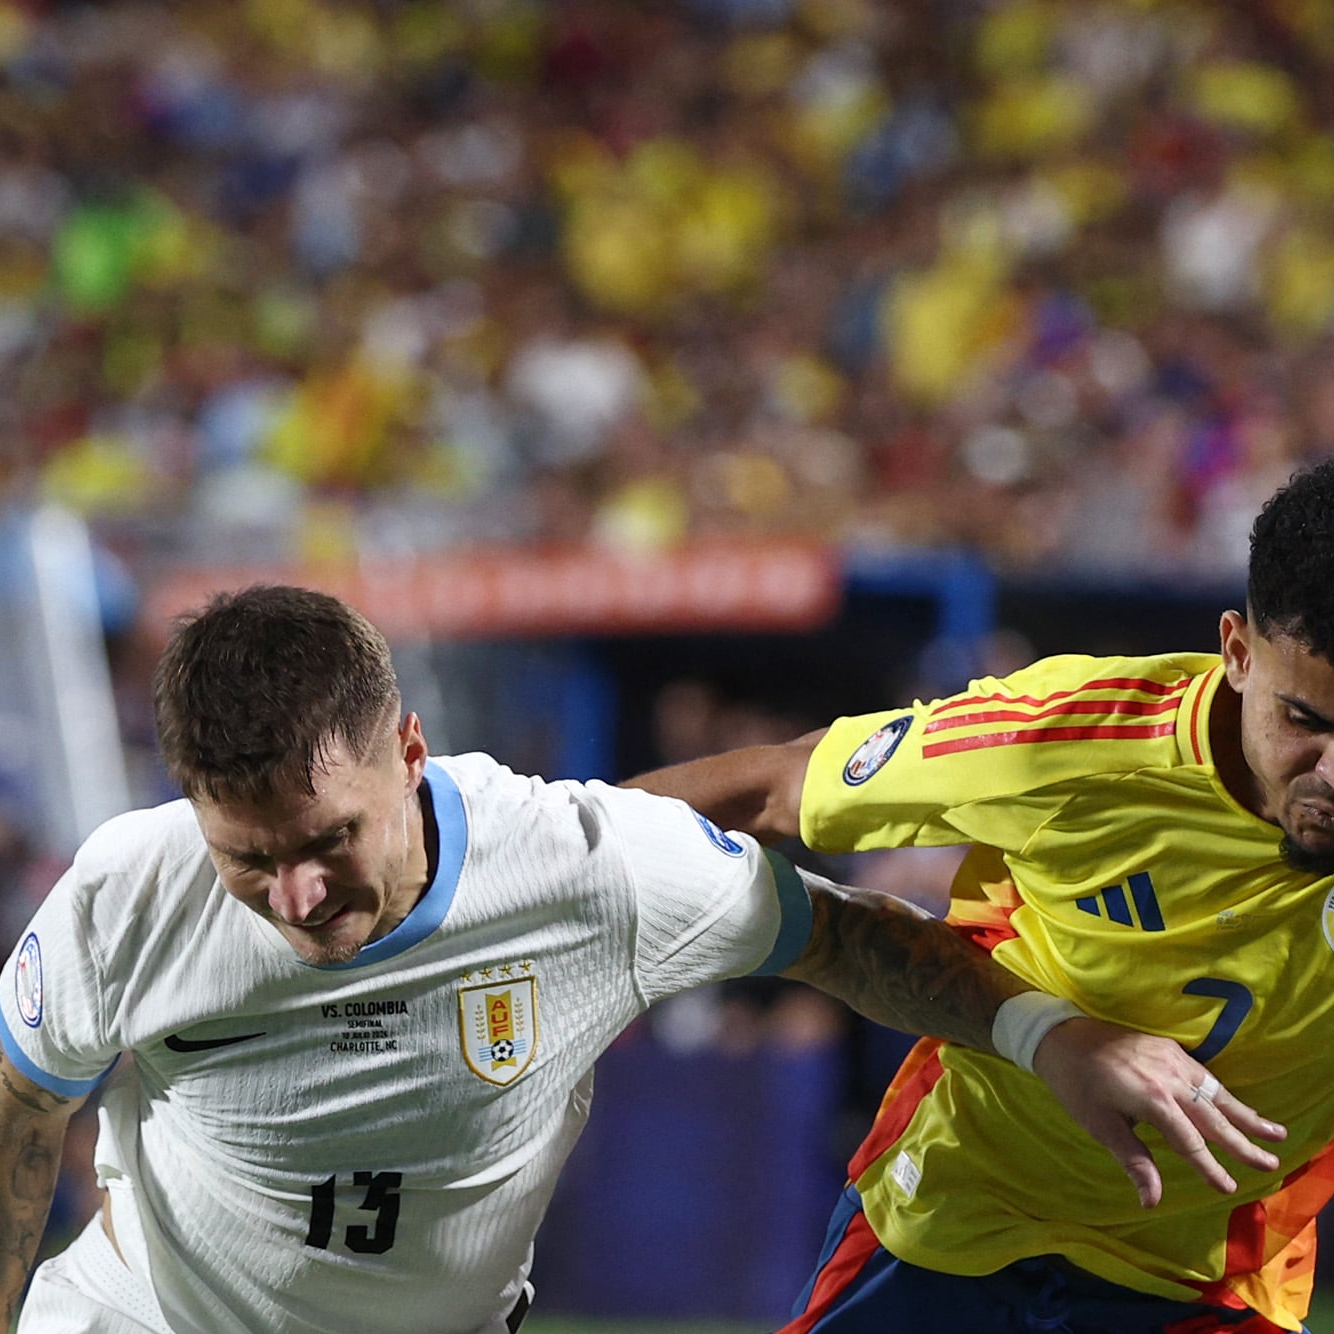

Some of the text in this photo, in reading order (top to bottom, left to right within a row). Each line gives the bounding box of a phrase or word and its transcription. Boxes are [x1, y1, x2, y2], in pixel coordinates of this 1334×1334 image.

[321, 1001, 408, 1018] VS. COLOMBIA
[491, 1000, 509, 1037] AUF
[1182, 977, 1254, 1064] 7
[330, 1040, 398, 1053] CHARLOTTE, NC
[305, 1171, 403, 1255] 13
